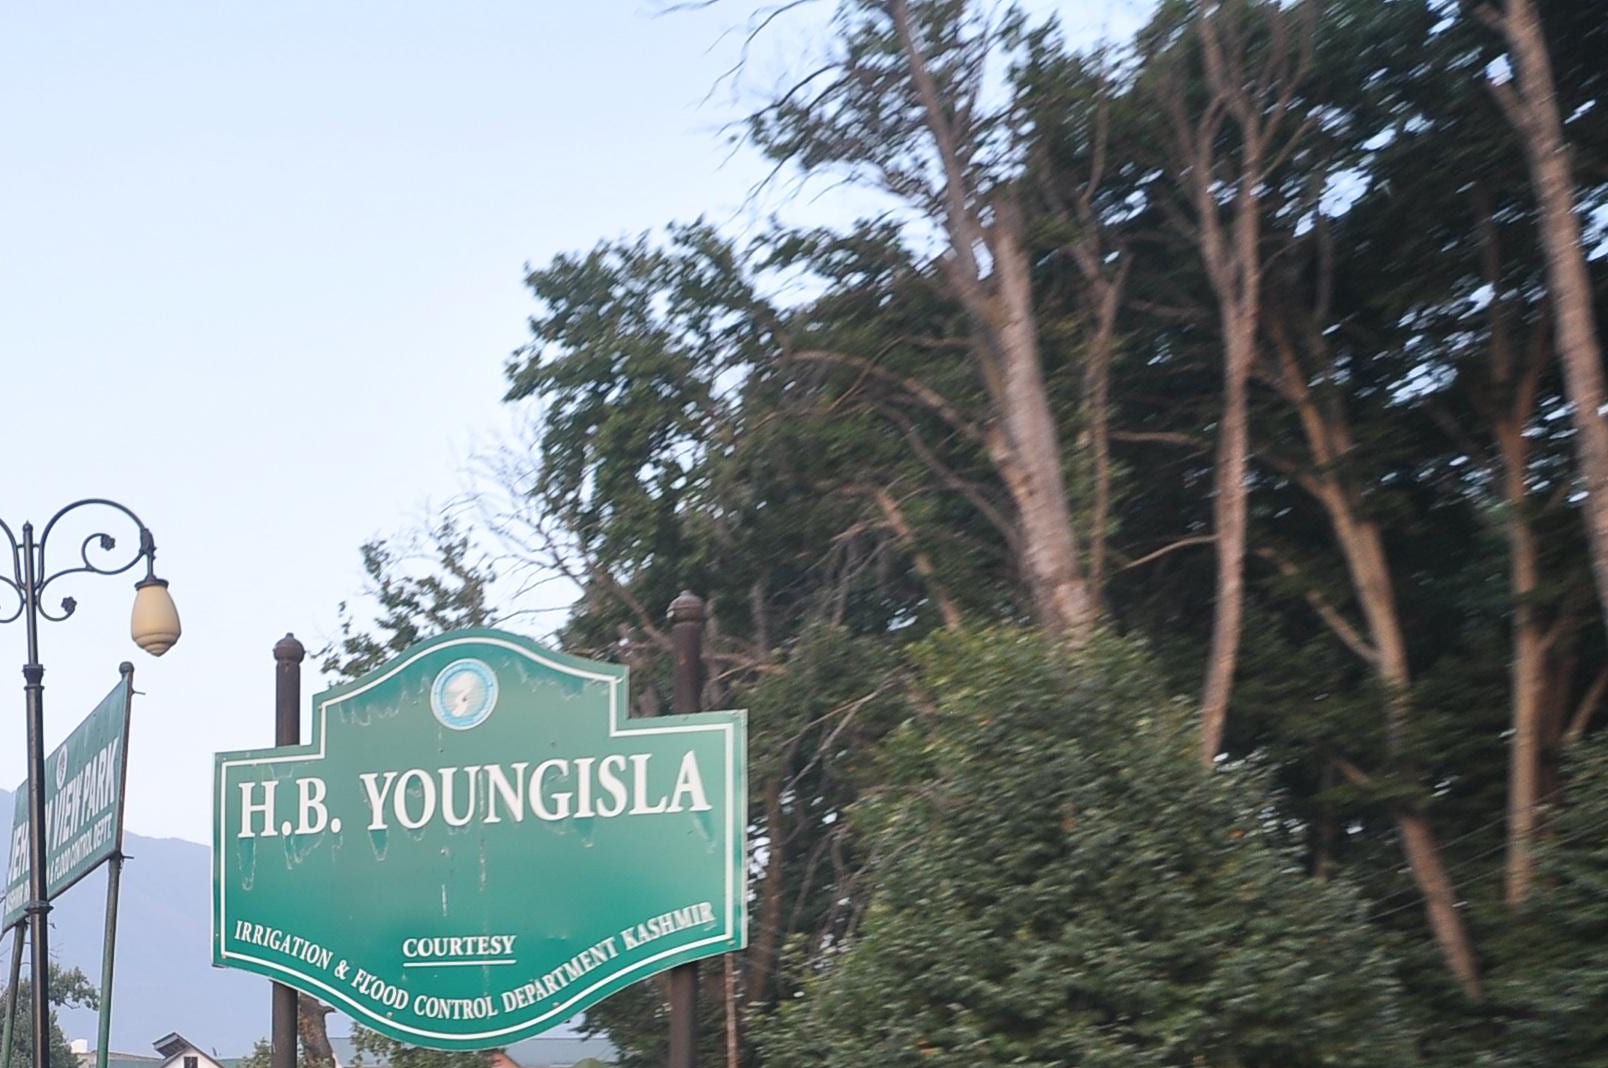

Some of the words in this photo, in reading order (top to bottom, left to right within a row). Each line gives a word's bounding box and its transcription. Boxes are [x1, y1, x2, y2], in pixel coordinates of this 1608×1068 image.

[52, 769, 83, 851] VIEW
[80, 735, 119, 827] PARK
[237, 776, 342, 839] H.B.
[360, 749, 712, 831] YOUNGISLA
[234, 920, 334, 970] IRRIGATION
[334, 960, 351, 981] &
[351, 968, 409, 1010] FLOOD
[413, 995, 498, 1020] CONTROL
[501, 936, 620, 1013] DEPARTMENT
[620, 901, 716, 951] KASHMIR
[402, 935, 517, 958] COURTESY
